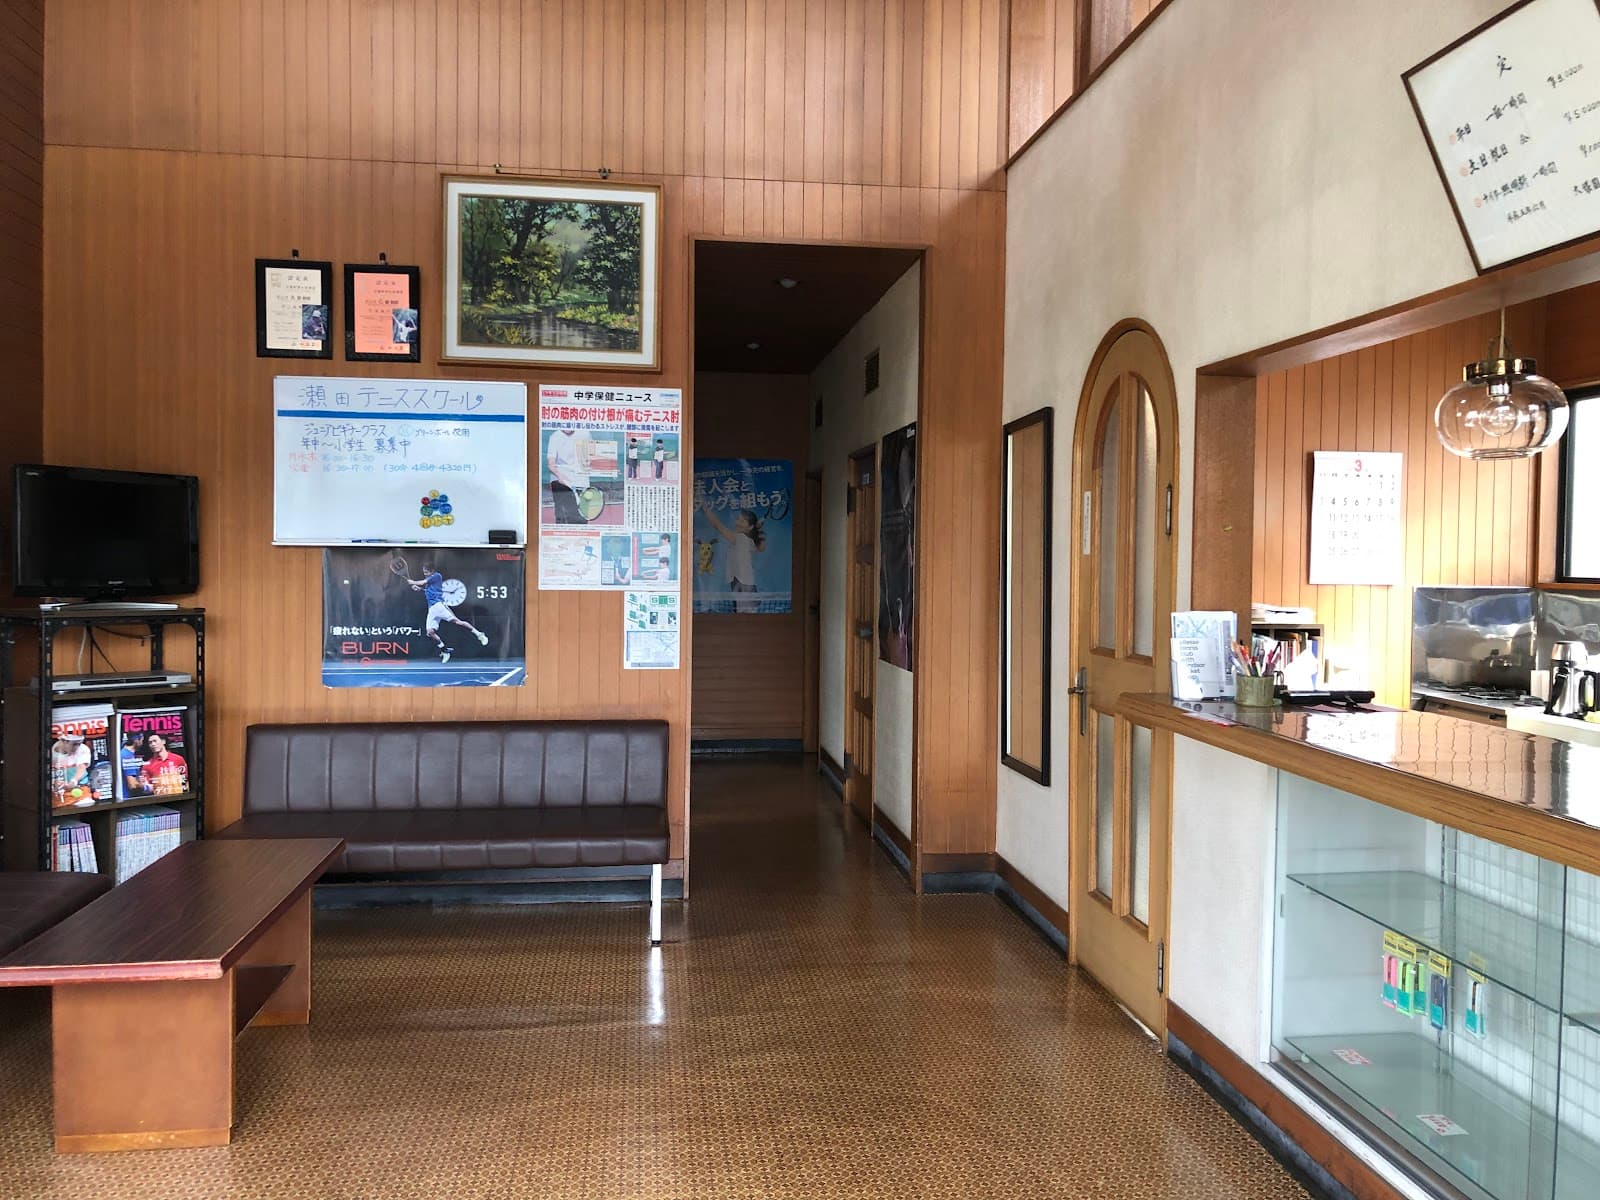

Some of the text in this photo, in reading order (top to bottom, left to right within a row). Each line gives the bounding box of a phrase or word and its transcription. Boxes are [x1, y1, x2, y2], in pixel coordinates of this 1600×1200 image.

[574, 391, 652, 402] 中学保健ニュース
[541, 406, 680, 424] 肘の筋肉の付け根が痛むテニス肘
[374, 436, 411, 458] 募集中
[1354, 459, 1362, 472] 3
[477, 586, 508, 599] 5:53
[342, 641, 409, 655] BURN
[52, 719, 107, 736] ennis
[122, 713, 182, 733] Tennis
